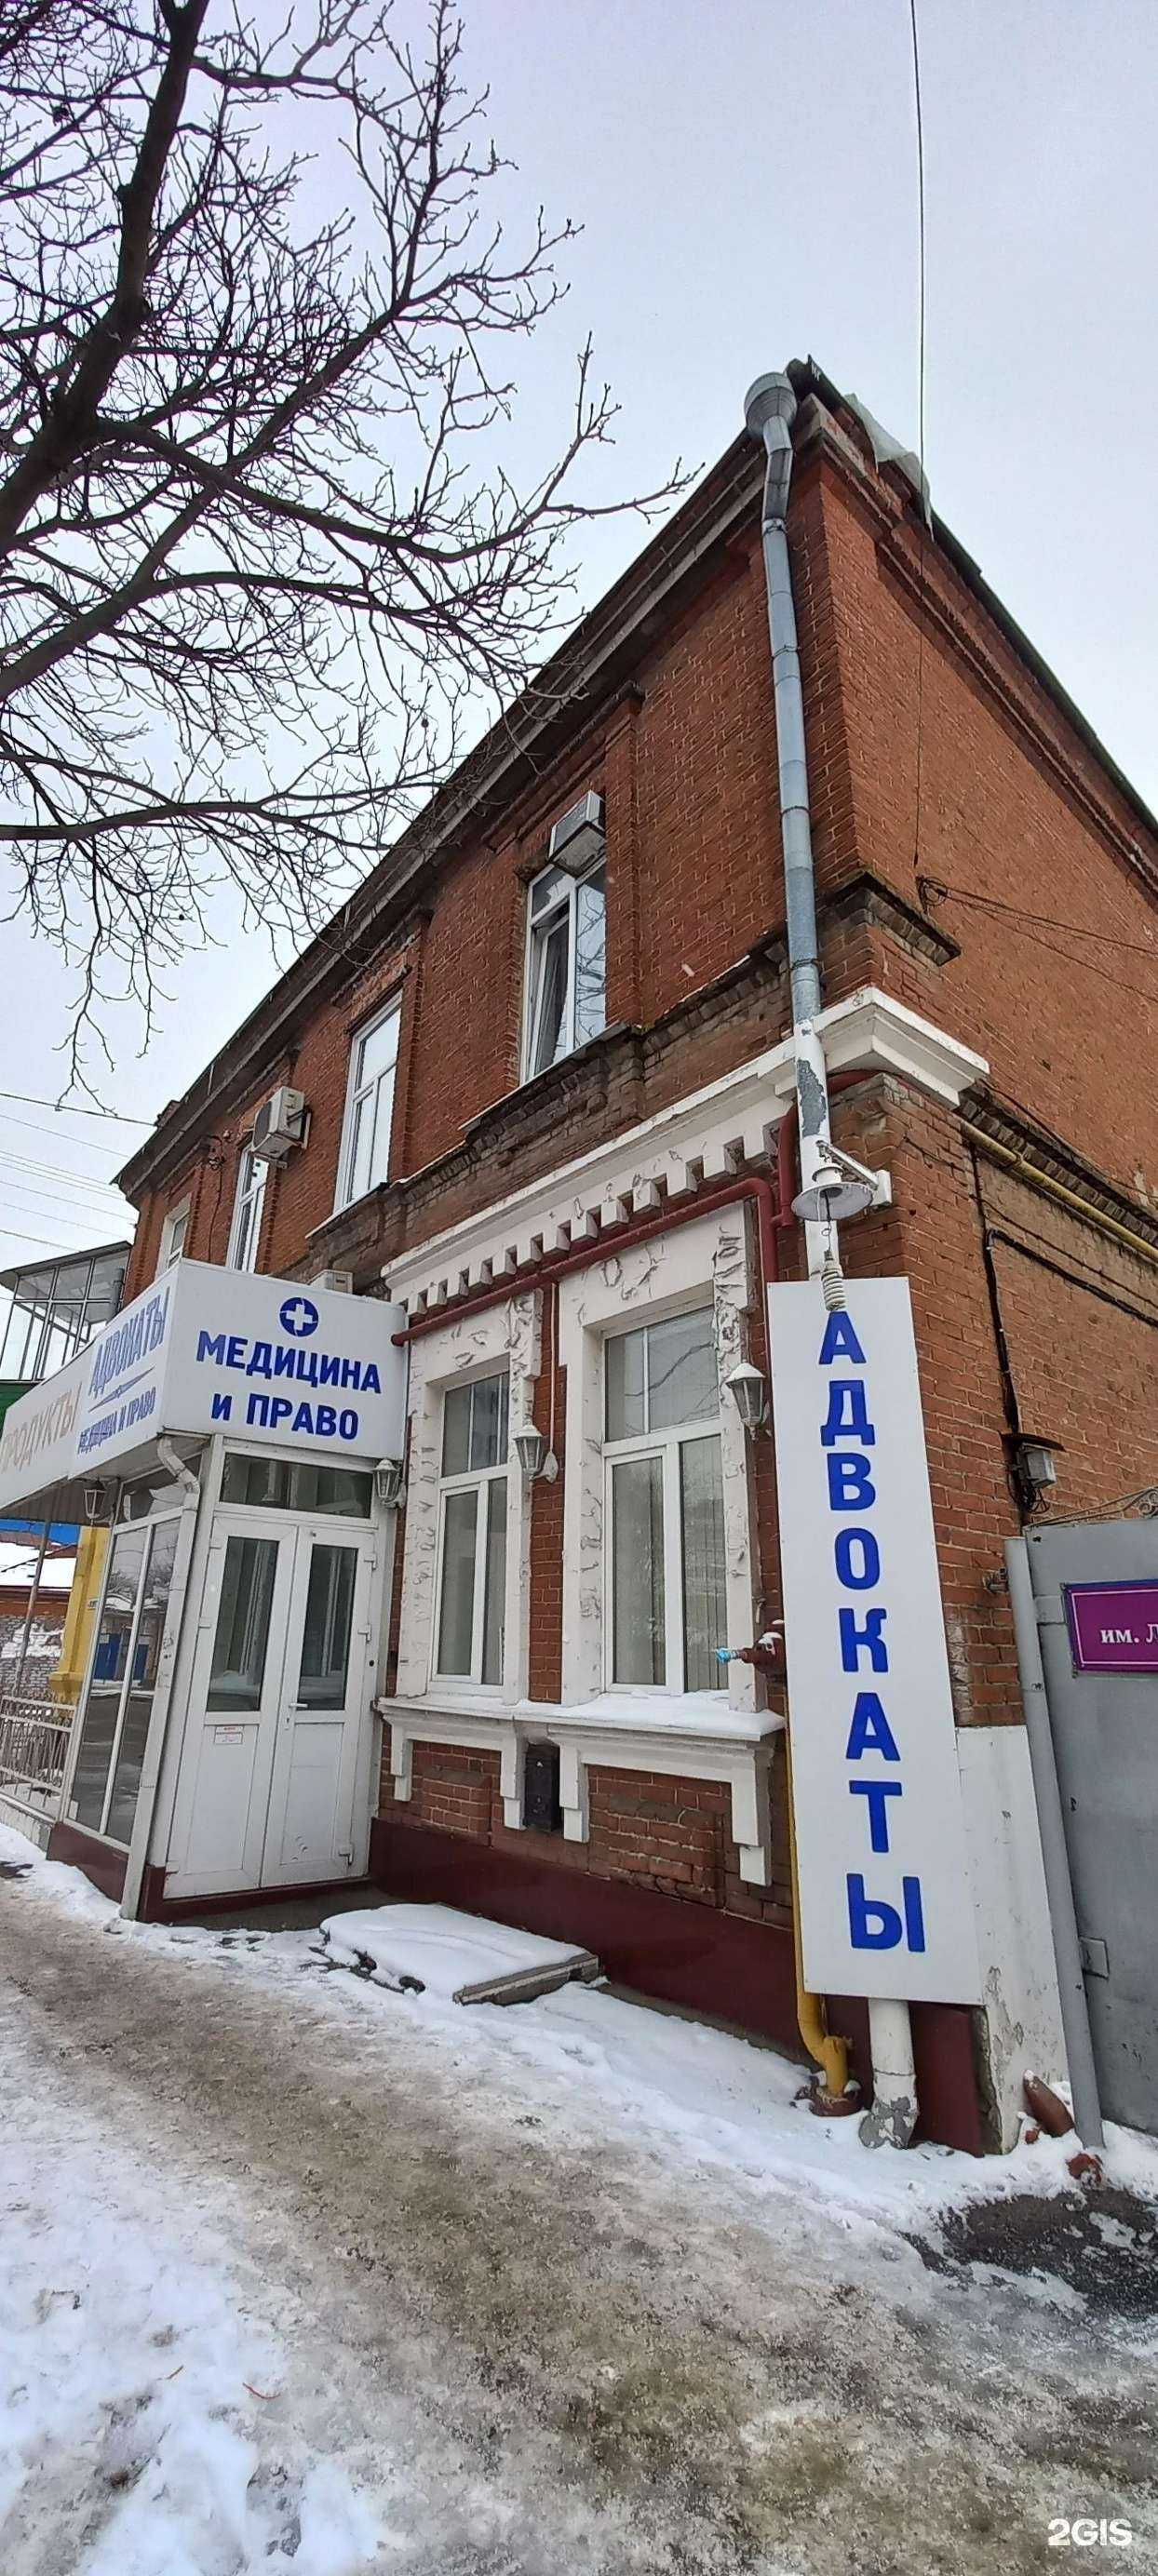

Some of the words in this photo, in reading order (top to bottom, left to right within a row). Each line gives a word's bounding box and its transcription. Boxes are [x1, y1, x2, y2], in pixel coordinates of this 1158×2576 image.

[88, 1286, 170, 1399] АДВОКАТЫ
[196, 1331, 382, 1394] МЕДИЦИНА
[127, 1387, 156, 1428] ПРАВО
[211, 1393, 232, 1421] И
[247, 1393, 358, 1441] ПРАВО
[819, 1310, 925, 1952] АДВОКАТЫ
[1100, 1629, 1139, 1644] им.
